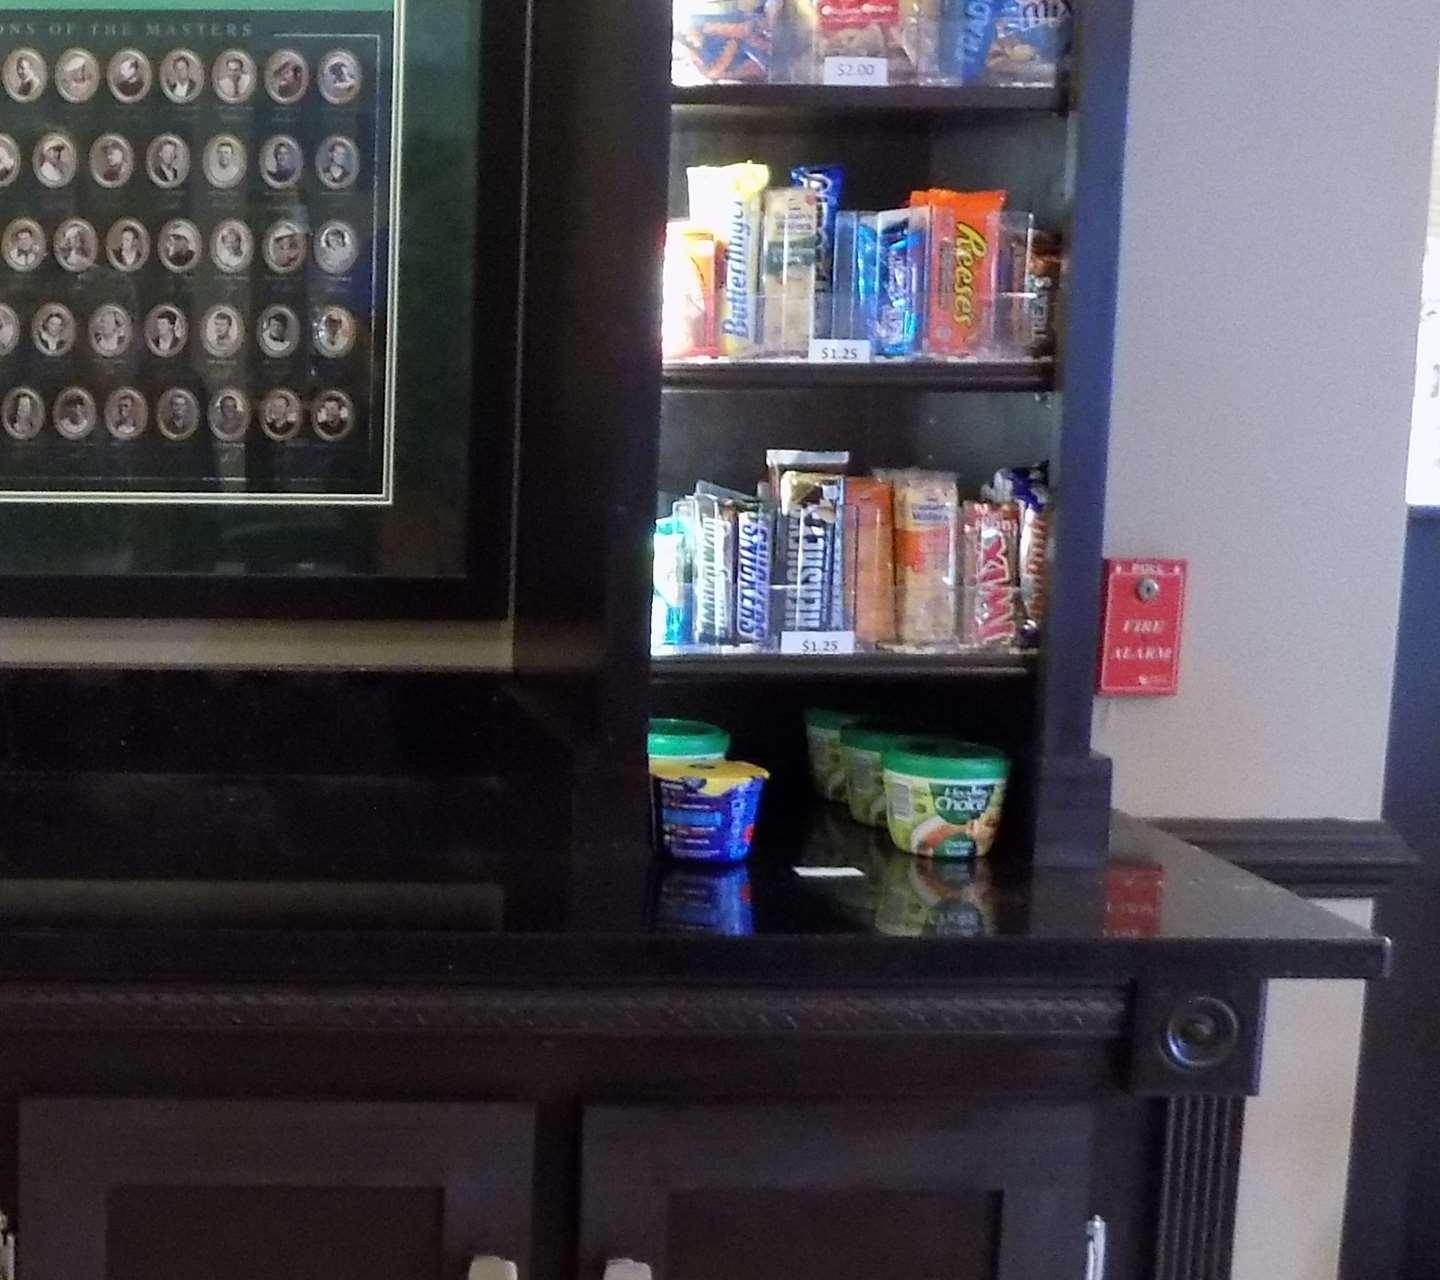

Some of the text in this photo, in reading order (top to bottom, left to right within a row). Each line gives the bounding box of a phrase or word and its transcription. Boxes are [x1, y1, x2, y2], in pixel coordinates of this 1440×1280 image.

[48, 22, 74, 37] OF
[90, 22, 132, 37] THE
[145, 22, 253, 38] MASTERS
[837, 63, 875, 77] $2.00
[719, 200, 750, 339] Butterfinger
[821, 346, 858, 360] $1.25
[801, 639, 839, 652] $1.25
